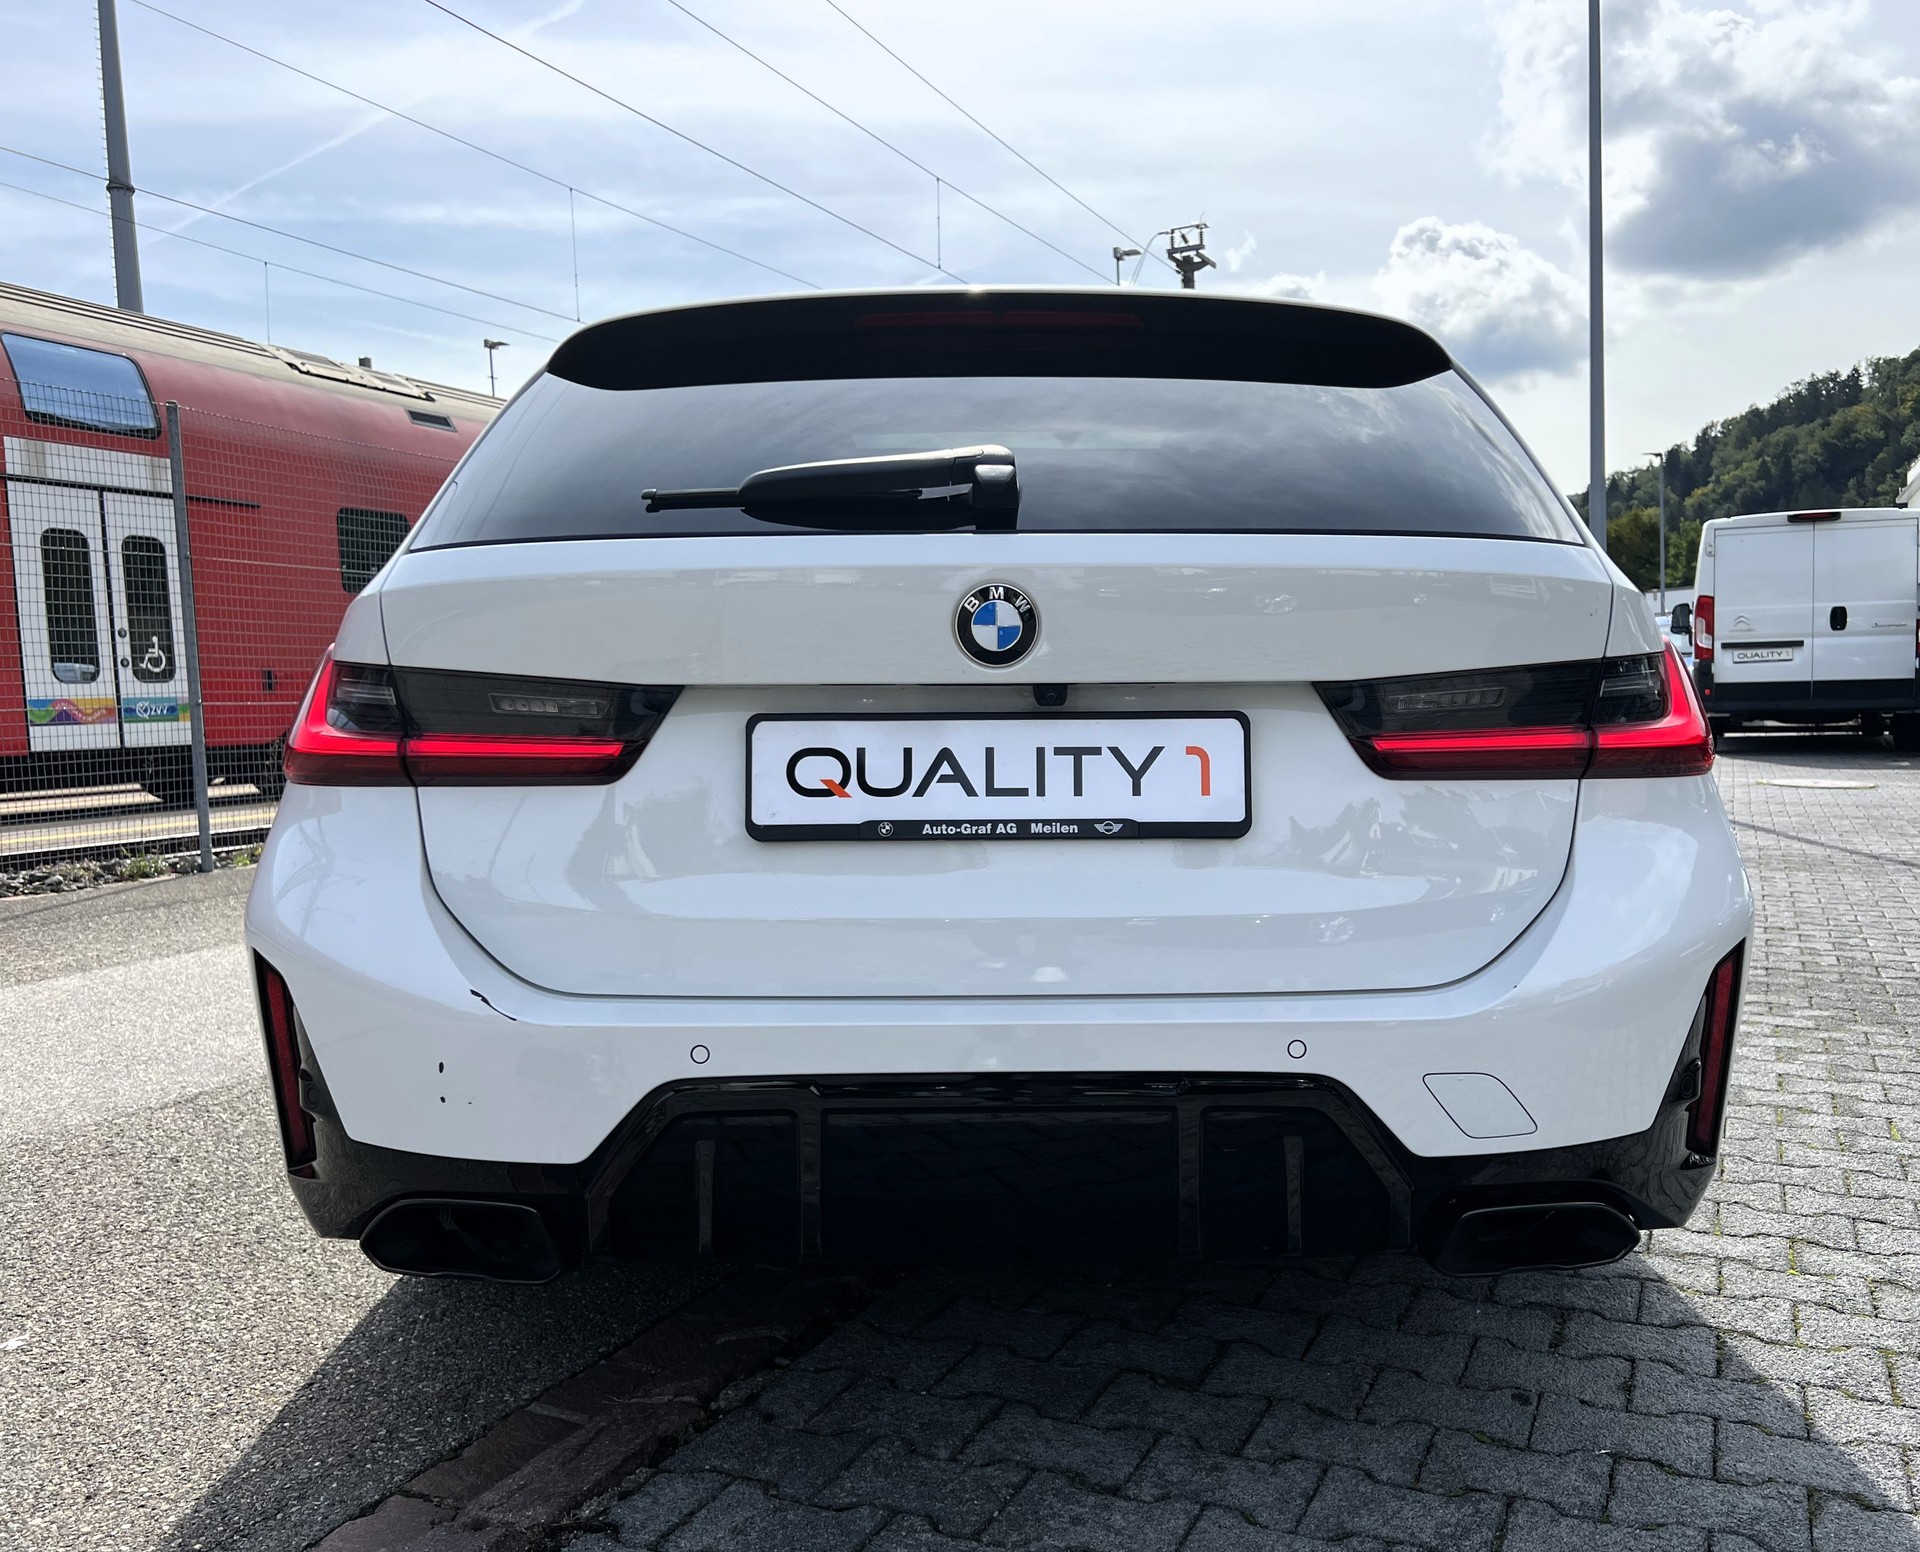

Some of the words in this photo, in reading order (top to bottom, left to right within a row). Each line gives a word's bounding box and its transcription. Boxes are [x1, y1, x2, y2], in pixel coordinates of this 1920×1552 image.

[964, 586, 1031, 613] BMW
[1737, 650, 1783, 659] QUALITY
[151, 705, 168, 715] ZVV
[786, 746, 1165, 798] QUALITY
[1185, 746, 1211, 796] 1
[922, 823, 992, 835] Auto-Graf
[995, 823, 1017, 834] AG
[1031, 822, 1078, 834] Meilen
